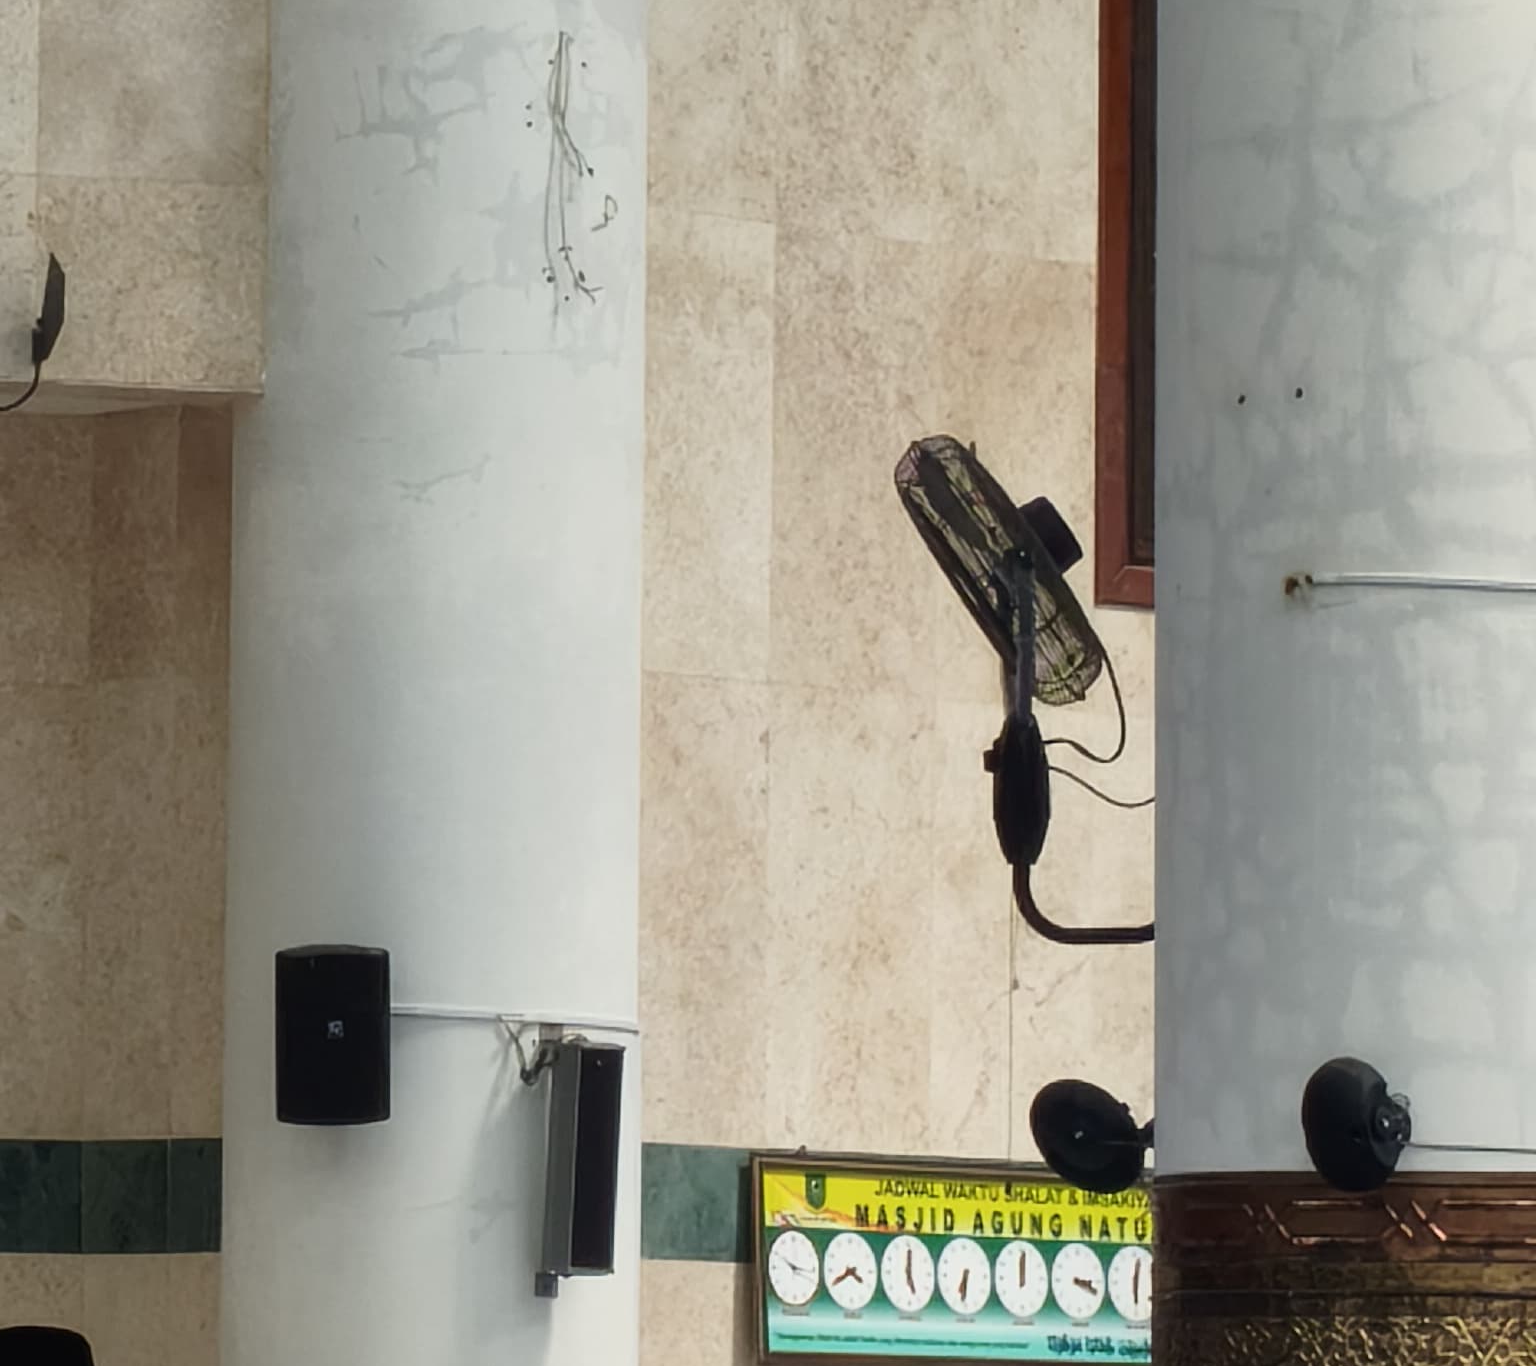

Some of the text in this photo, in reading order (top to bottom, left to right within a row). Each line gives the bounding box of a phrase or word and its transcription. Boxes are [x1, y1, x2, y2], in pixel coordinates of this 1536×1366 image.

[874, 1179, 940, 1198] JADWAL
[944, 1182, 999, 1202] WAKTU
[854, 1203, 956, 1232] MASJID
[973, 1208, 1063, 1237] AGUNG
